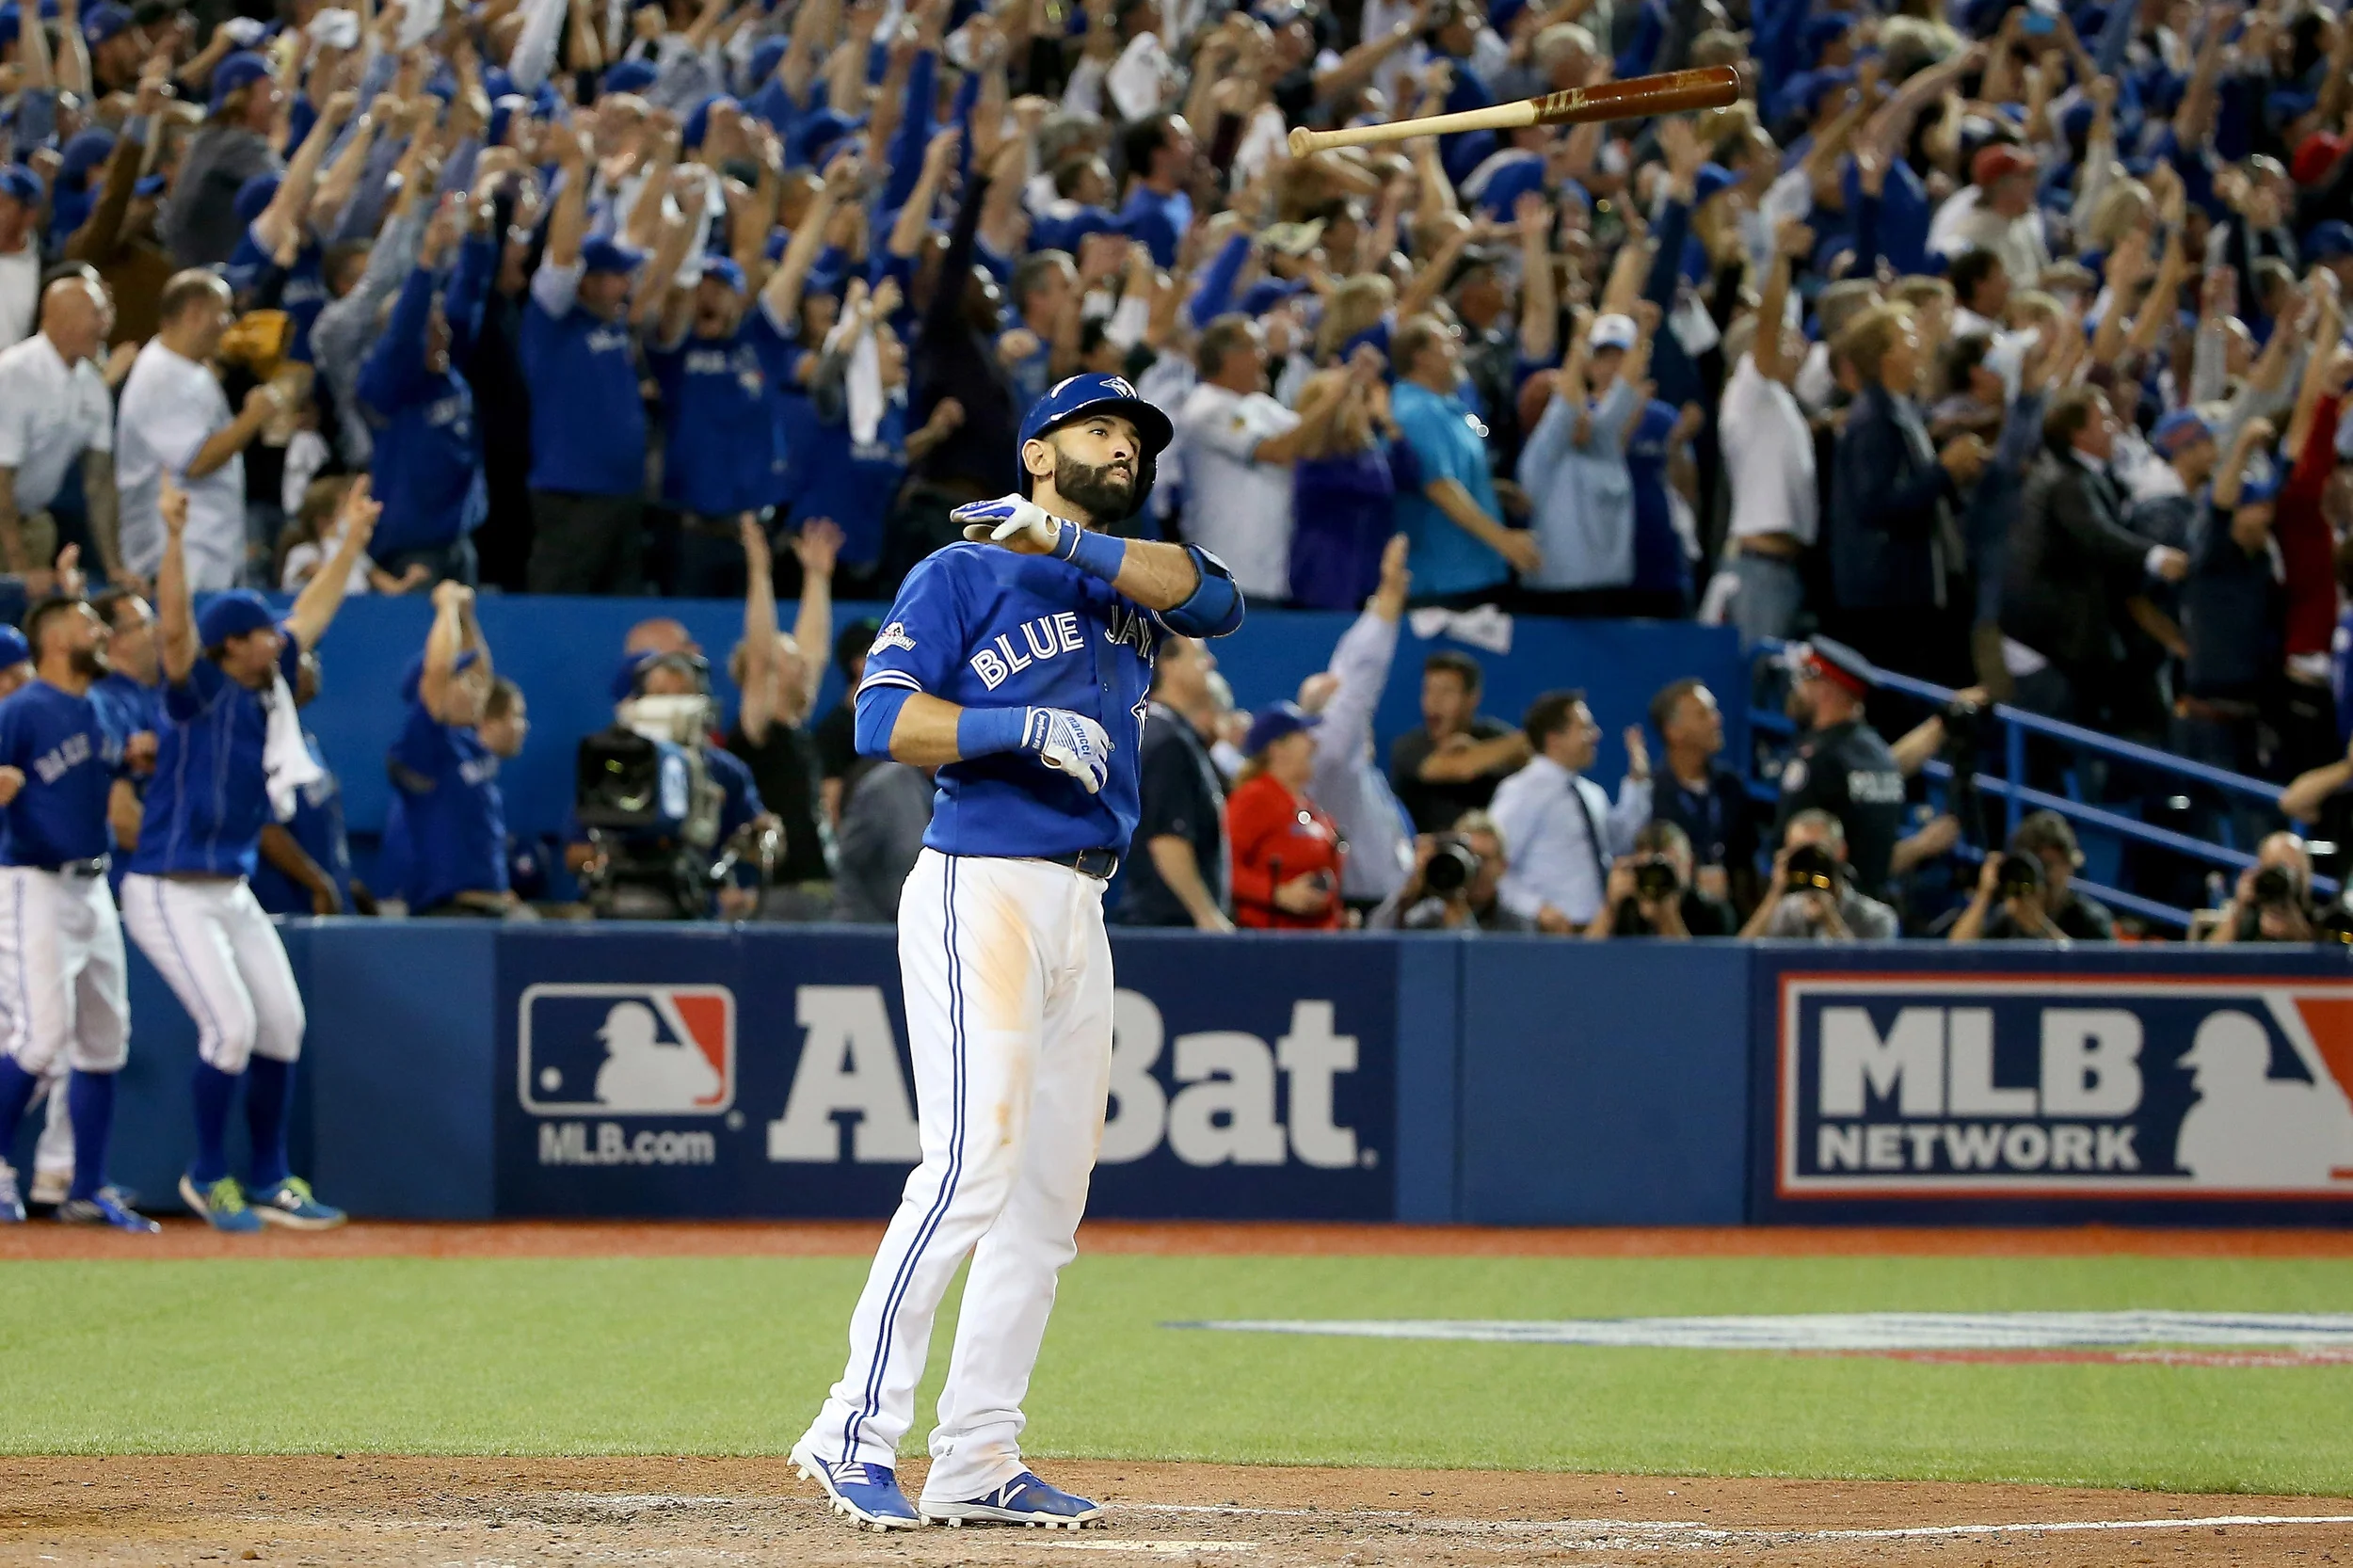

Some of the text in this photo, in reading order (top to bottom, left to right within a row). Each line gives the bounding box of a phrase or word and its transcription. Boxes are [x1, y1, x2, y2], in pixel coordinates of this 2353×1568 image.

[969, 605, 1154, 692] BLUE JAY
[1065, 715, 1092, 756] marucci
[1818, 1006, 2144, 1118] MLB
[537, 1121, 715, 1166] MLB.com
[1816, 1124, 2142, 1172] NETWORK
